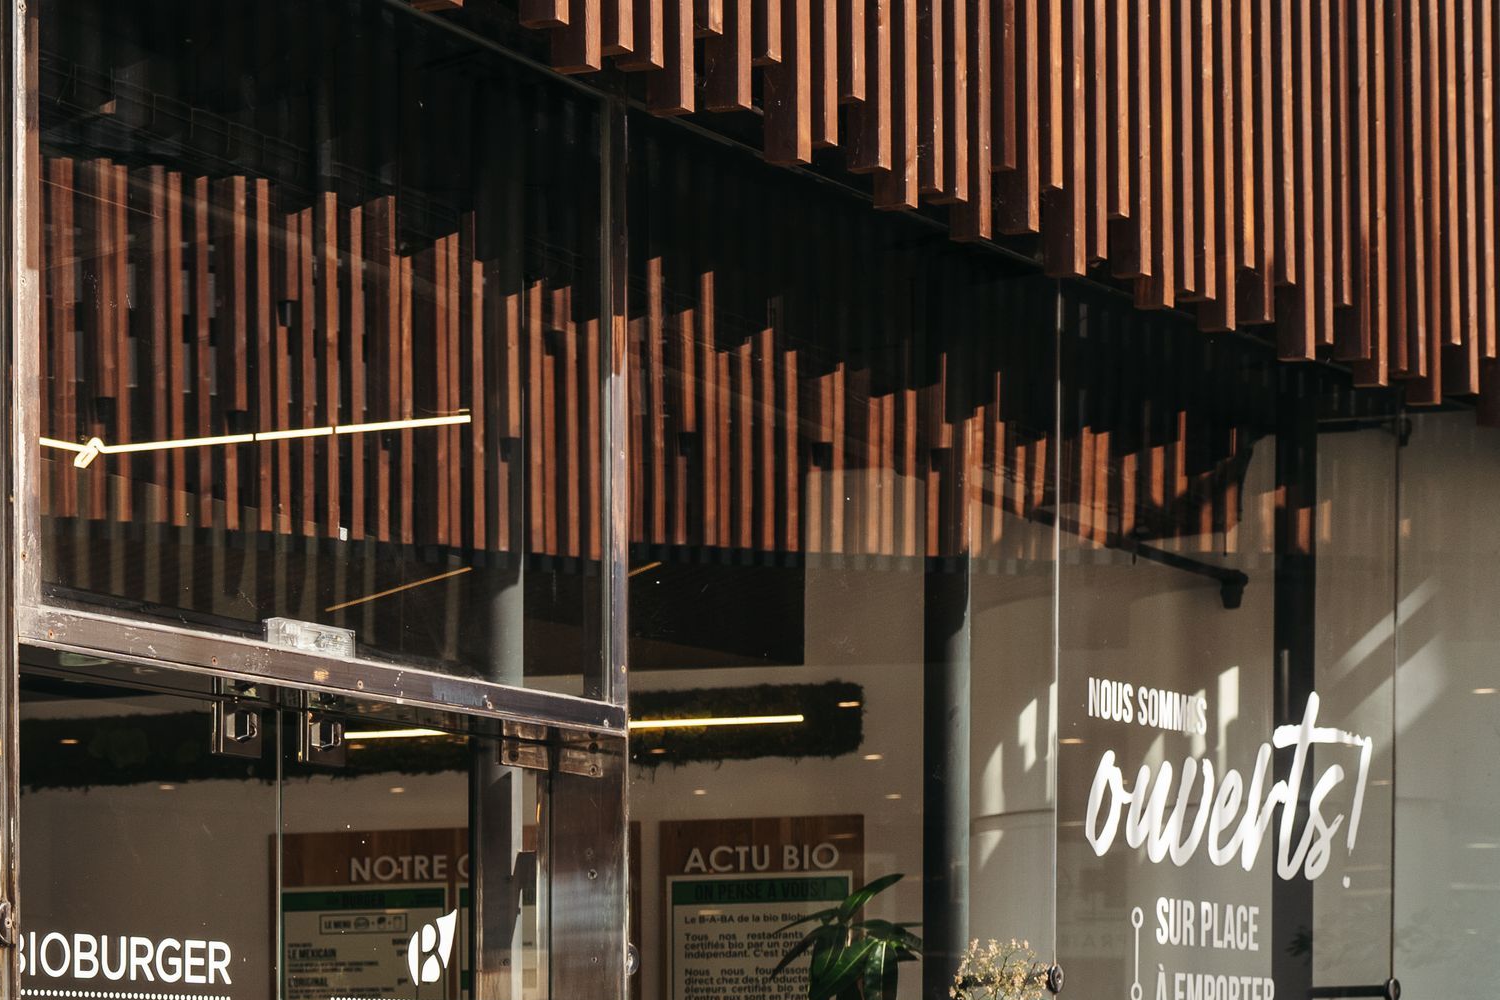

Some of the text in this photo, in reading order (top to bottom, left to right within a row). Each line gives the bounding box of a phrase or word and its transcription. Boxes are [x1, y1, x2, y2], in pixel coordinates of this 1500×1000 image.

[1088, 676, 1208, 735] NOUS SOMMES
[1085, 691, 1373, 889] ouverts!
[684, 842, 840, 873] ACTU BIO
[349, 854, 448, 882] NOTRE
[718, 882, 763, 900] PENSE
[781, 880, 819, 898] VOUS
[685, 916, 697, 924] Le
[737, 914, 750, 923] de
[752, 913, 760, 922] la
[763, 913, 779, 922] bio
[1156, 897, 1260, 951] SUR PLACE
[685, 932, 708, 941] Tous
[747, 930, 804, 940] restaurants
[685, 940, 725, 950] certifiés
[728, 939, 744, 949] bio
[747, 941, 764, 950] par
[685, 950, 750, 960] indépendant.
[753, 949, 779, 958] C'est
[685, 968, 710, 977] Nous
[720, 968, 745, 976] nous
[685, 976, 713, 985] direct
[716, 976, 739, 985] chez
[742, 975, 760, 984] des
[731, 983, 772, 993] certifiés
[777, 983, 794, 992] bio
[744, 992, 766, 1000] sont
[769, 993, 782, 1000] en
